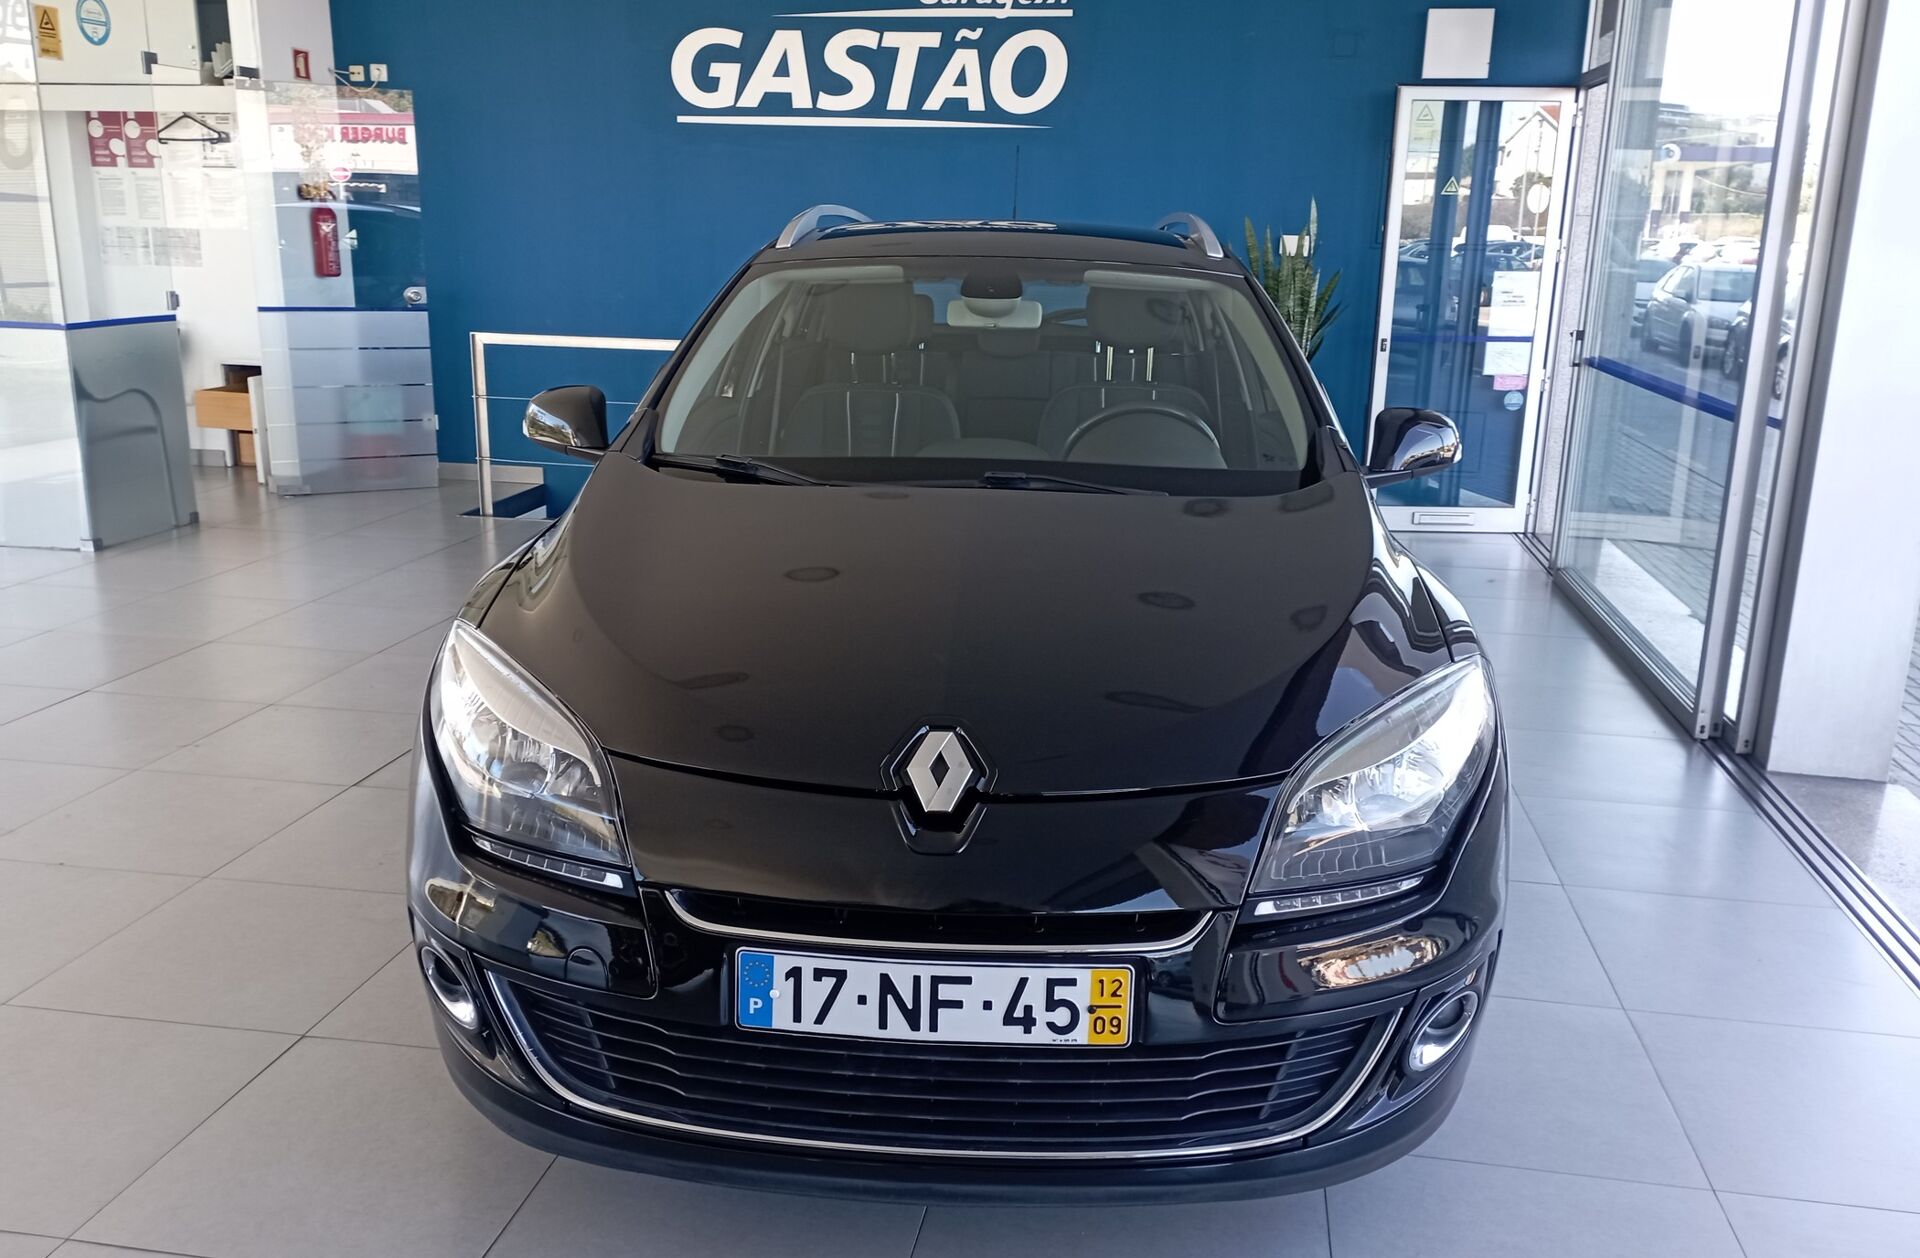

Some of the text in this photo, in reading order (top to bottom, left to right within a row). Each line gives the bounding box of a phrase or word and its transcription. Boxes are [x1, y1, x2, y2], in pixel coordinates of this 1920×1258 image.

[670, 27, 1069, 115] GASTÃO
[1098, 978, 1123, 998] 12
[748, 997, 763, 1014] P
[1093, 1015, 1122, 1036] 09
